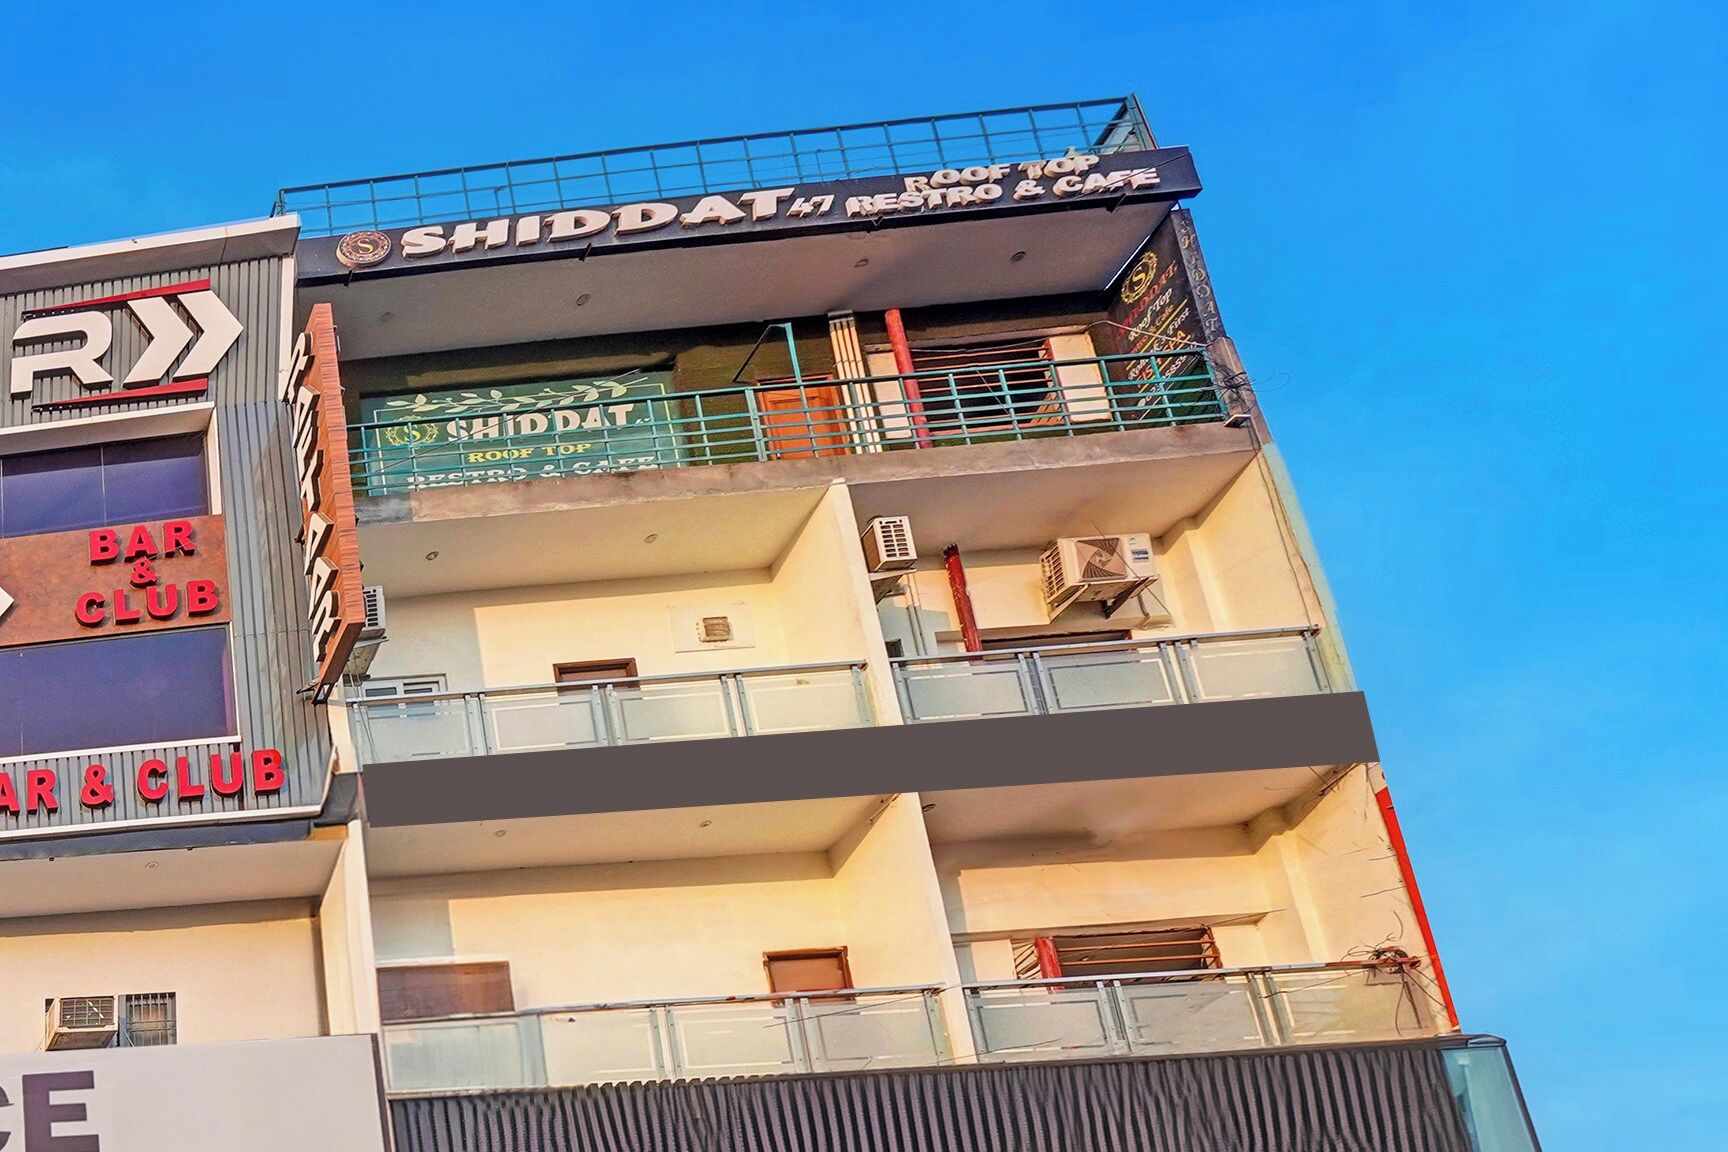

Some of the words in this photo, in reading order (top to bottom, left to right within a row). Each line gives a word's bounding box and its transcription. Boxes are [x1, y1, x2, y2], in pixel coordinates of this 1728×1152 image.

[904, 163, 1011, 192] ROOF
[1016, 153, 1100, 181] TOP
[401, 187, 795, 258] SHIDDAT
[787, 194, 835, 218] 47
[846, 184, 1004, 218] RESTRO
[1012, 179, 1046, 201] &
[1051, 167, 1161, 197] CAFE
[445, 402, 635, 441] SHIDDAT
[467, 447, 536, 463] ROOF
[542, 442, 593, 457] TOP
[286, 330, 342, 663] RAFTAAR
[89, 520, 197, 566] BAR
[129, 556, 159, 588] &
[75, 578, 219, 627] CLUB
[80, 764, 116, 808] &
[136, 748, 286, 803] CLUB
